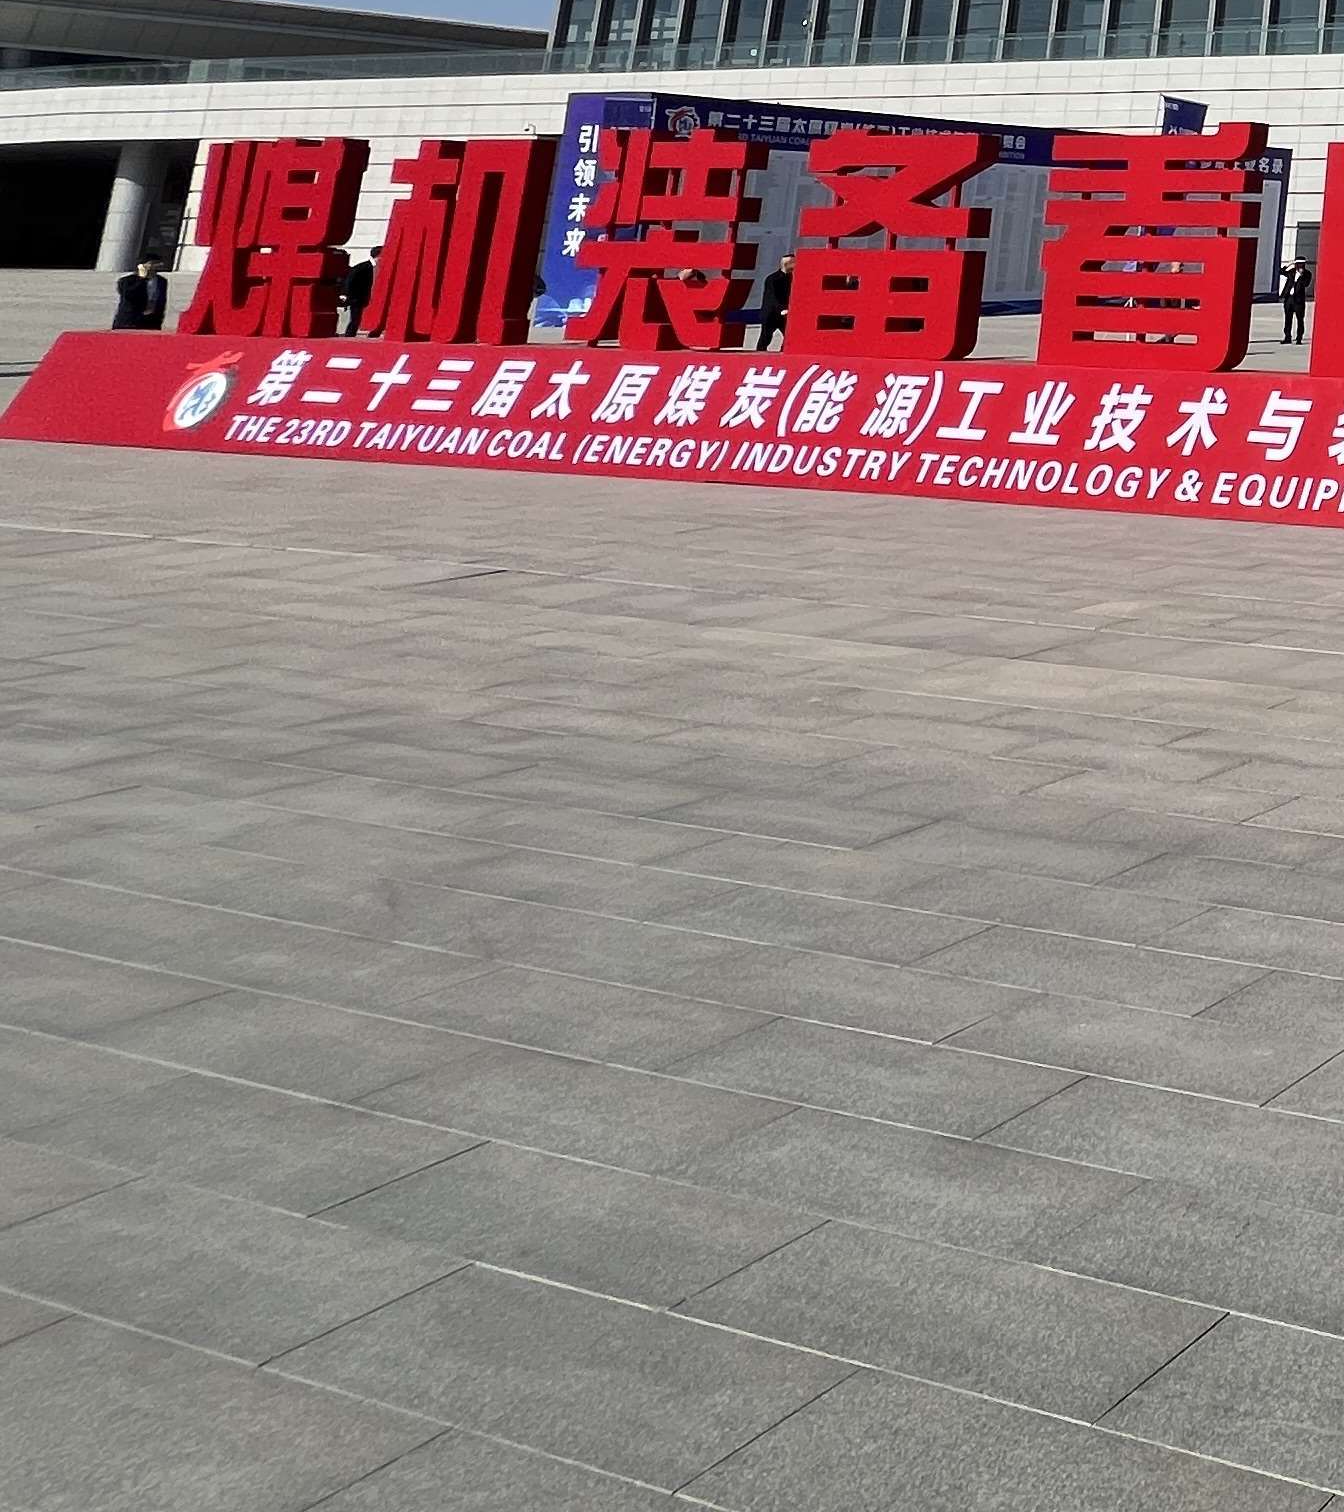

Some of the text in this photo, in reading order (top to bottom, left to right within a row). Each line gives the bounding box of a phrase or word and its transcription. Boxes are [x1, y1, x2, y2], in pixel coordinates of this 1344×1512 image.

[224, 415, 283, 443] THE
[274, 417, 353, 447] 23RD
[351, 422, 490, 456] TAIYUAN
[486, 430, 569, 461] COAL
[572, 433, 730, 472] (ENERGY)
[730, 441, 912, 482] INDUSTRY
[915, 452, 1172, 501] TECHNOLOGY
[1174, 469, 1204, 503] &
